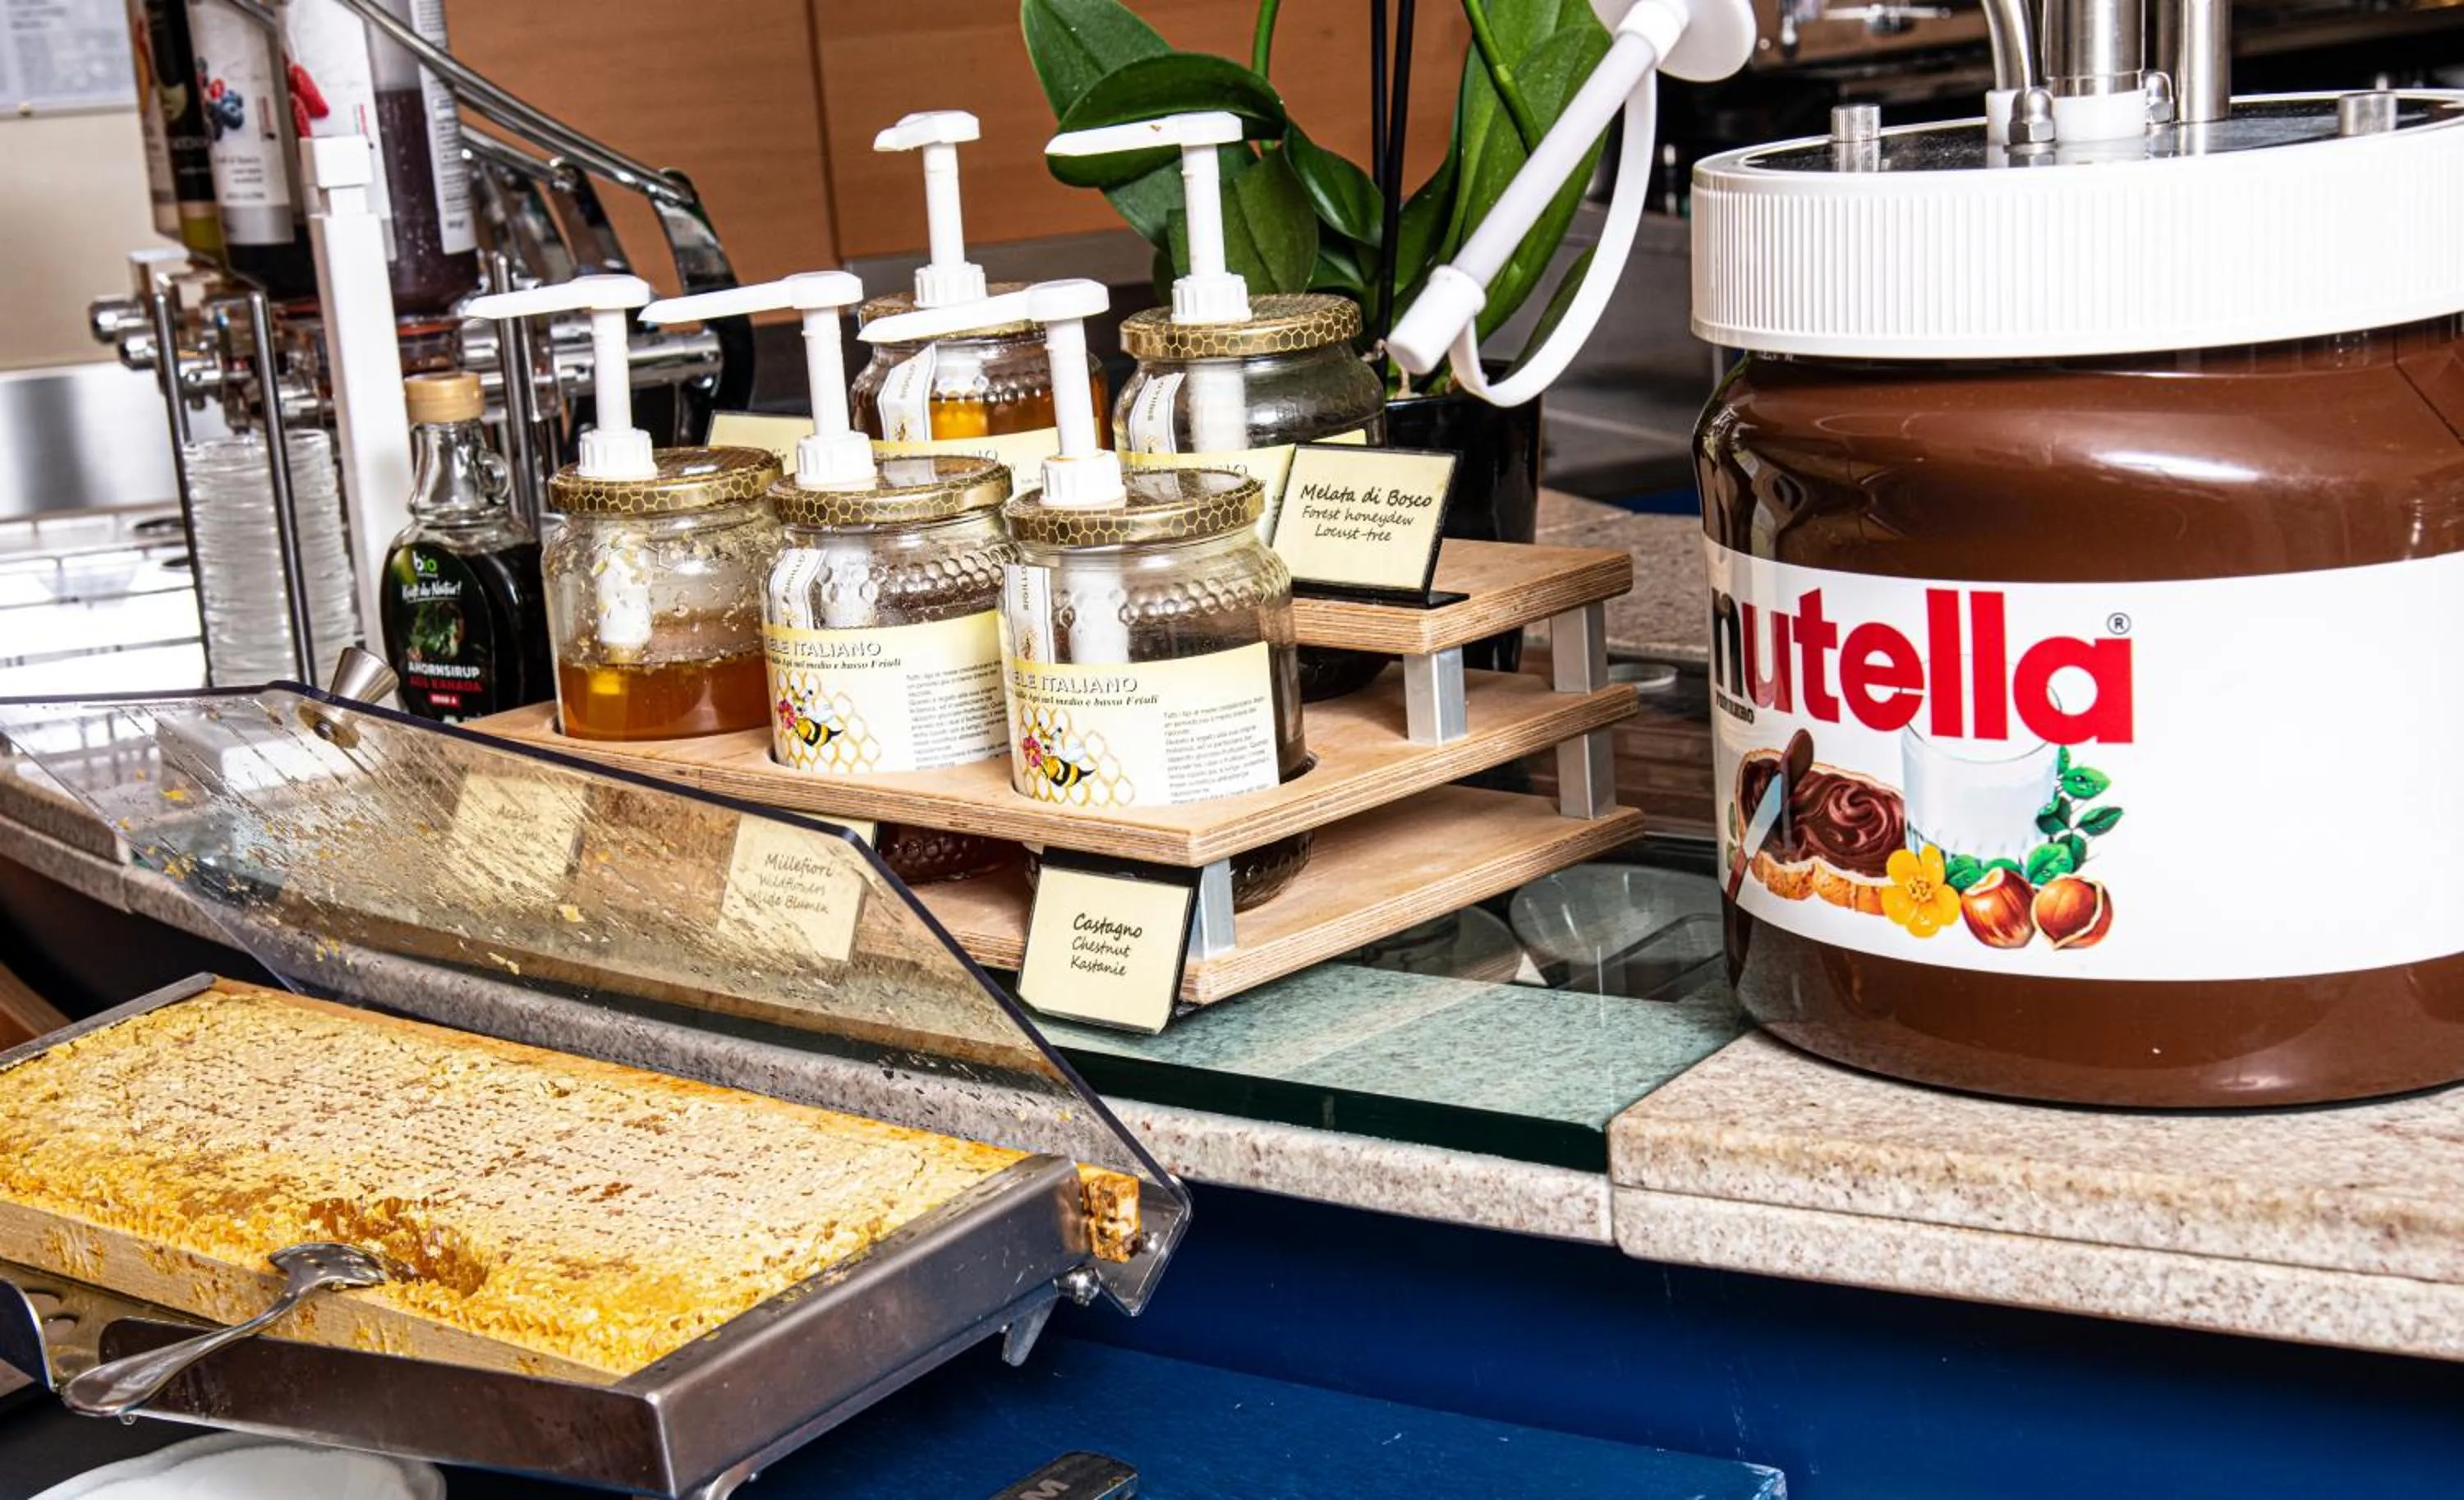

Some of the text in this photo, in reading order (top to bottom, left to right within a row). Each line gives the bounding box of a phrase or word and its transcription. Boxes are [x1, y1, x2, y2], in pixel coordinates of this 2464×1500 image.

[1299, 483, 1432, 508] Melata di Bosco
[1302, 505, 1340, 520] Forest
[1345, 507, 1414, 527] honeydew
[1314, 523, 1392, 542] Locust-tree
[412, 550, 438, 573] bio
[793, 641, 882, 659] ITALIANO
[407, 661, 480, 679] AHORNSIRUP
[841, 660, 868, 670] basso
[871, 658, 902, 669] Friuli
[1712, 587, 2134, 745] nutella
[1041, 674, 1138, 694] ITALIANO
[1055, 696, 1083, 707] medio
[1093, 697, 1123, 707] basso
[1126, 695, 1158, 706] Friuli
[765, 854, 834, 878] Millefiori
[1073, 912, 1143, 941] Castagno
[1071, 936, 1132, 959] Chestnut
[1070, 955, 1127, 977] Kastanie
